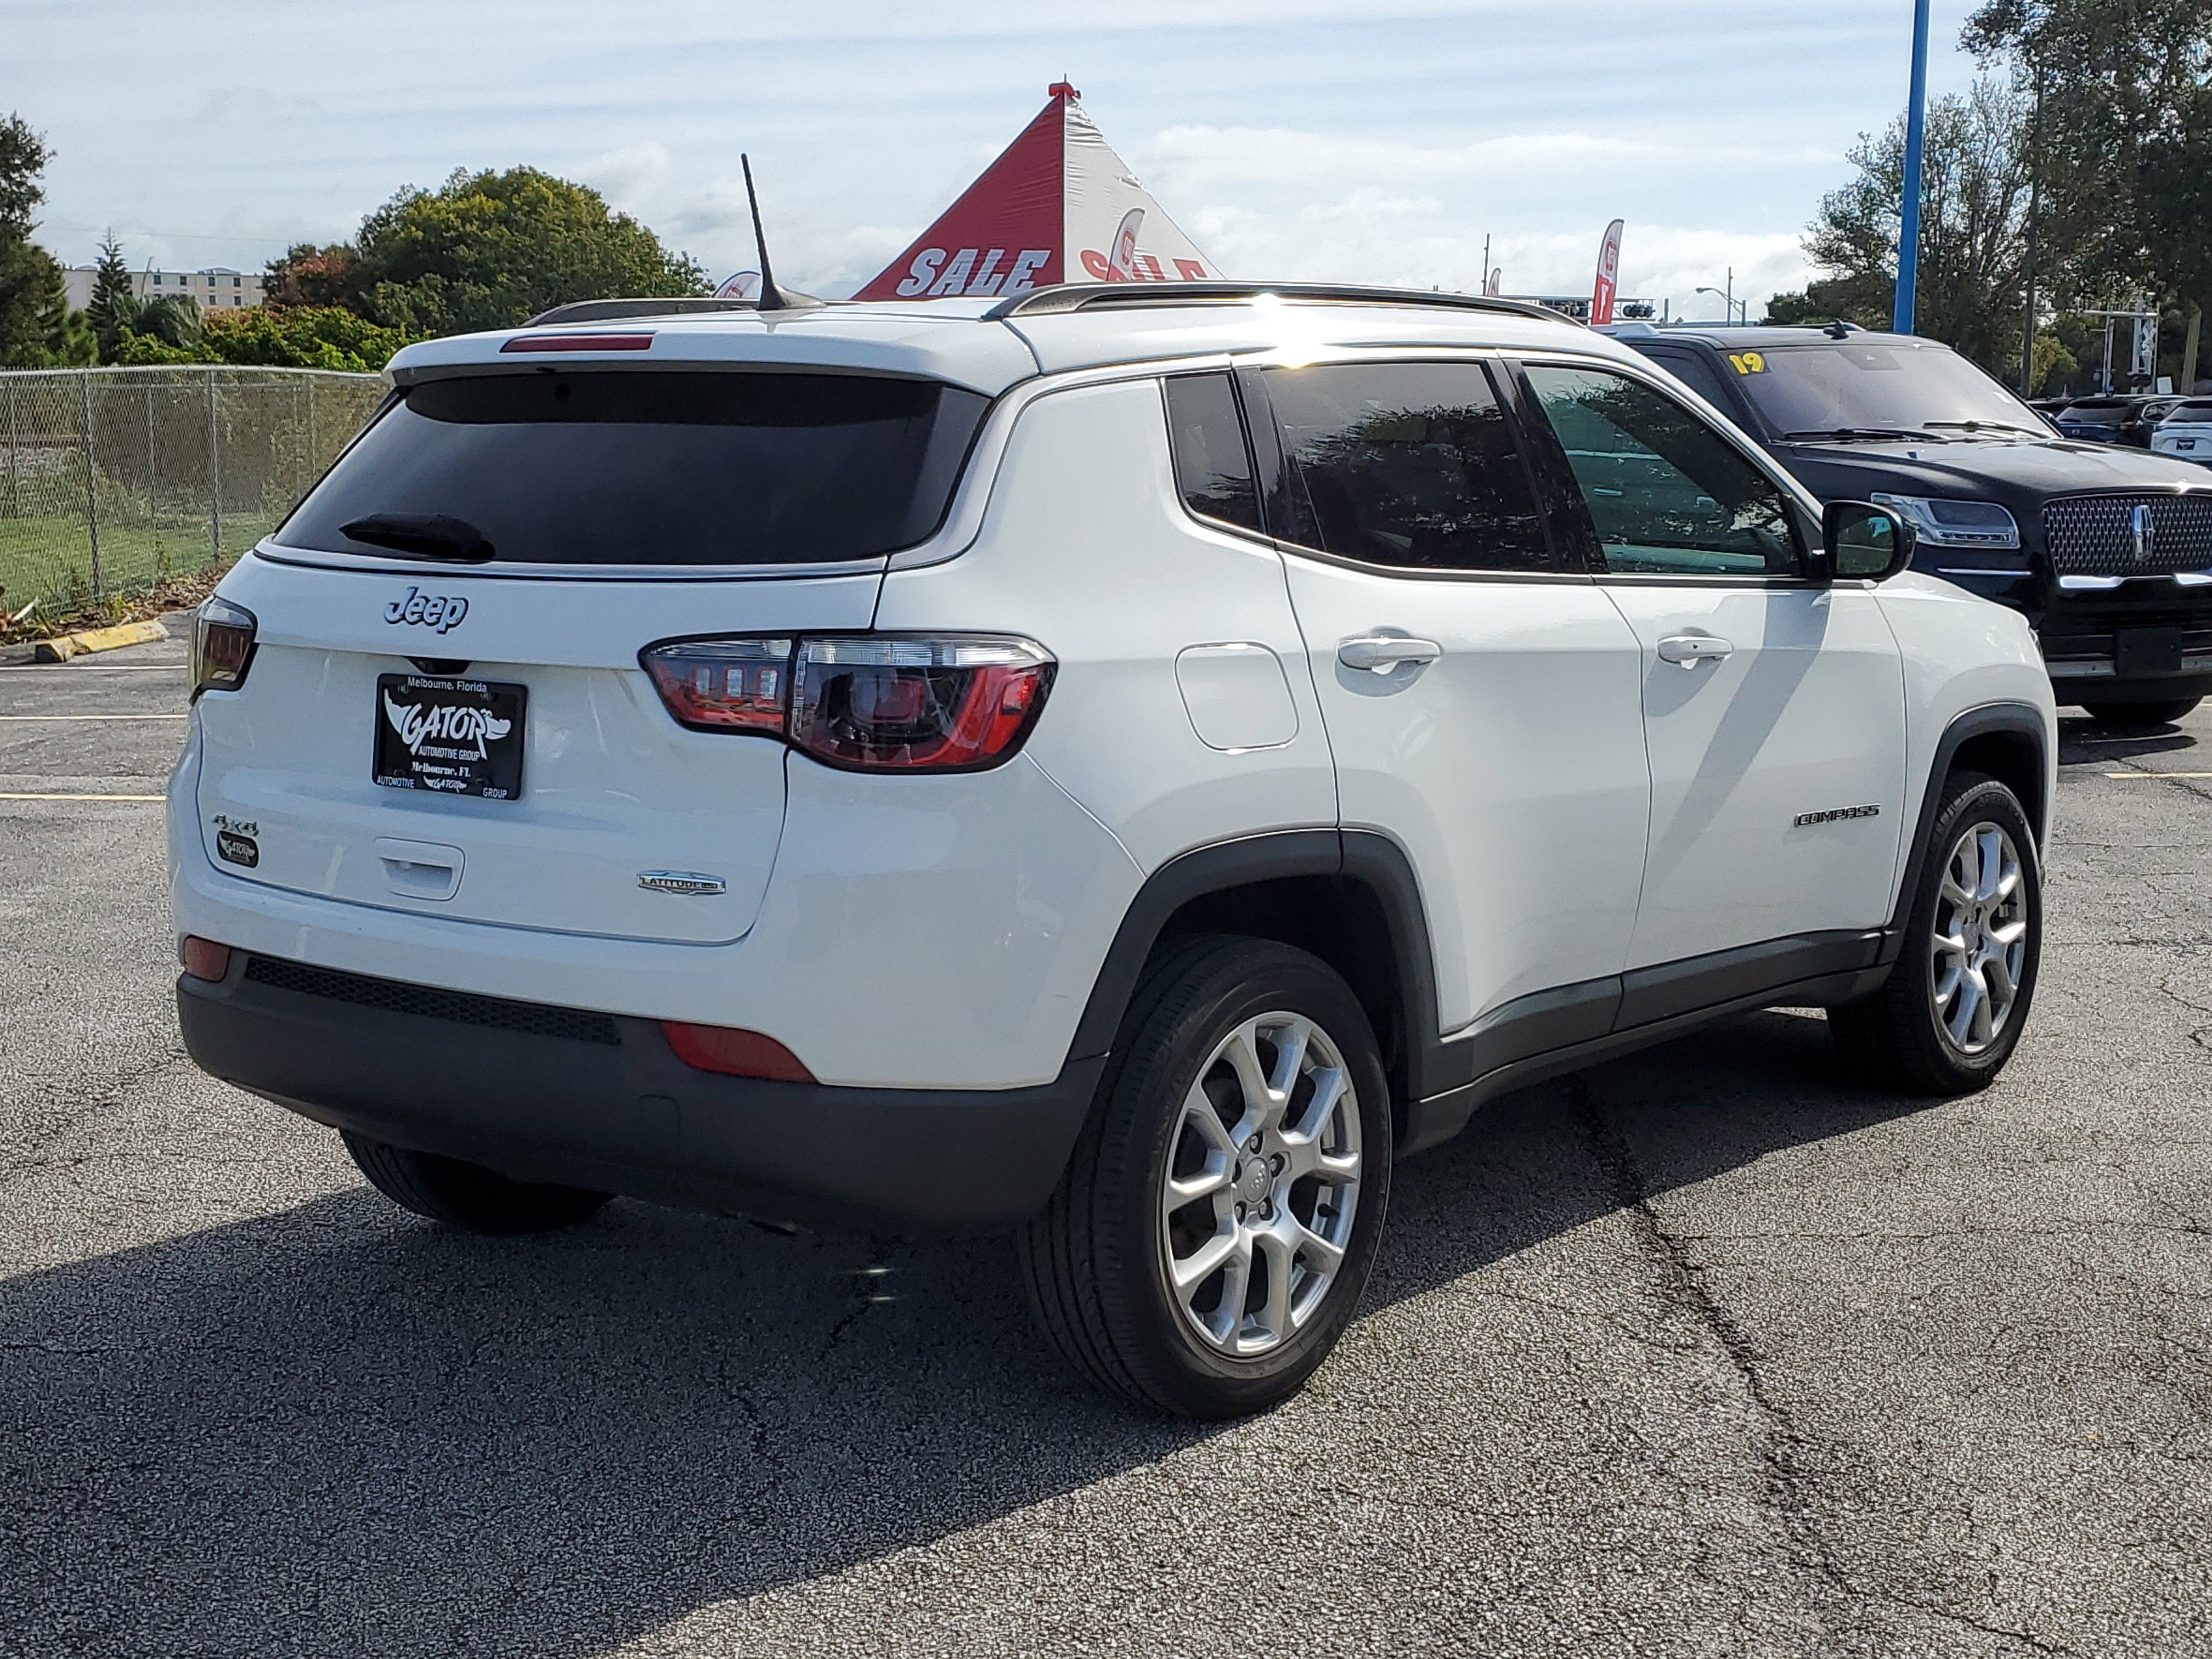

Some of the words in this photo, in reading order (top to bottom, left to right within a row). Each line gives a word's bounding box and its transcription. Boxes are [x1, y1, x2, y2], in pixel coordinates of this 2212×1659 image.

[895, 247, 1052, 296] SALE
[1728, 352, 1764, 374] 19
[385, 586, 469, 634] Jeep
[456, 681, 487, 692] Florida
[402, 702, 488, 760] GATOR
[419, 745, 458, 760] AUTOMOTIVE
[459, 750, 481, 761] GROUP
[377, 775, 415, 789] AUTOMOTIVE
[433, 777, 461, 793] GATOR
[483, 787, 507, 799] GROUP
[1794, 803, 1881, 828] COMPASS
[639, 877, 702, 889] LATITUDE
